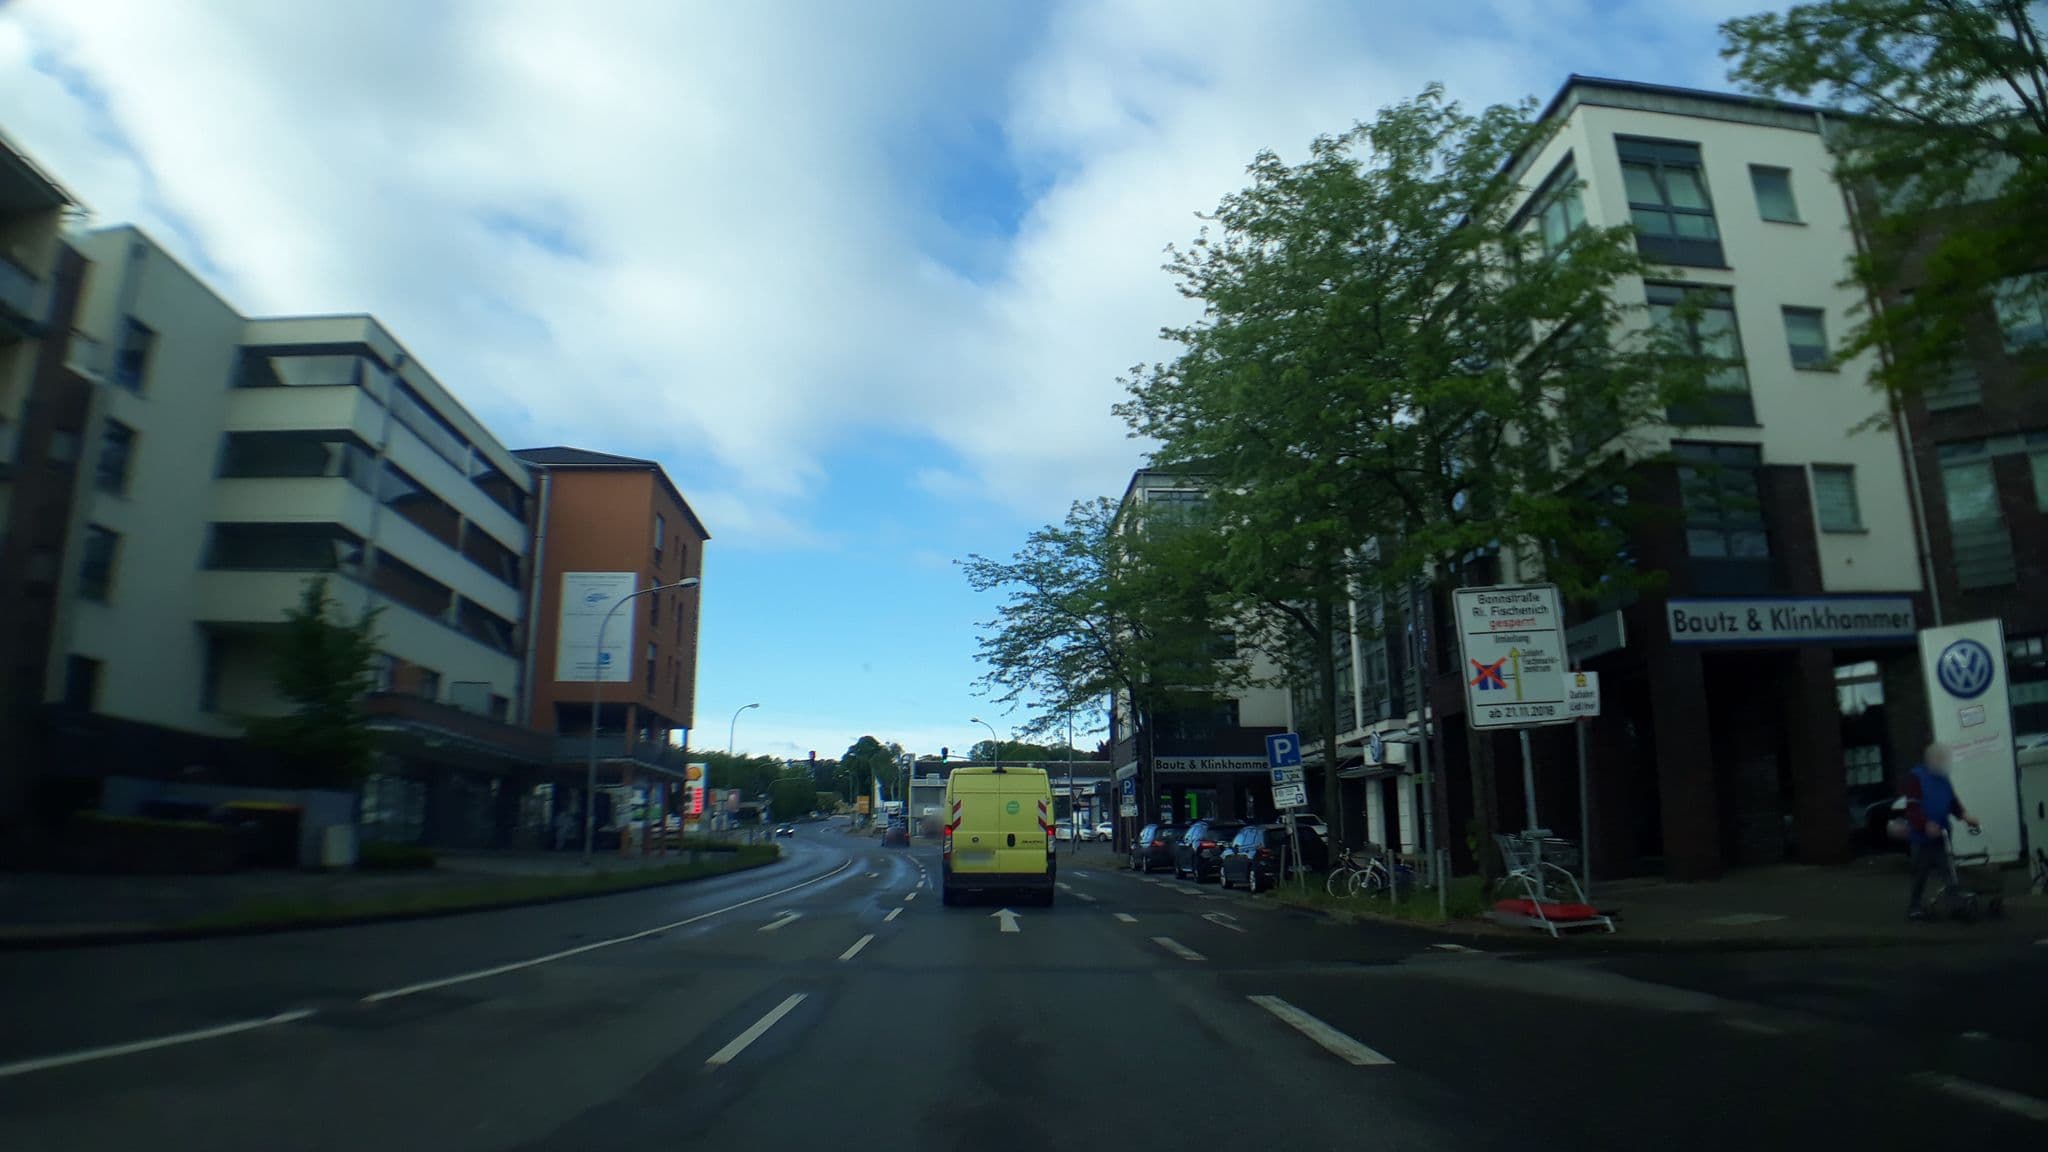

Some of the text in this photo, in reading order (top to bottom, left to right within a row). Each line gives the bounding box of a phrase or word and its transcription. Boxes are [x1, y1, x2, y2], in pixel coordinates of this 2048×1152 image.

[1478, 592, 1540, 605] Bonnstraße
[1491, 604, 1549, 616] Fischenich
[1490, 618, 1537, 631] gesperrt
[1672, 606, 1911, 633] Bautz & Klinkhammer
[1489, 706, 1502, 719] ab
[1273, 738, 1292, 764] P
[1156, 759, 1269, 769] Bautz & Klinkhamme
[1123, 780, 1131, 794] P
